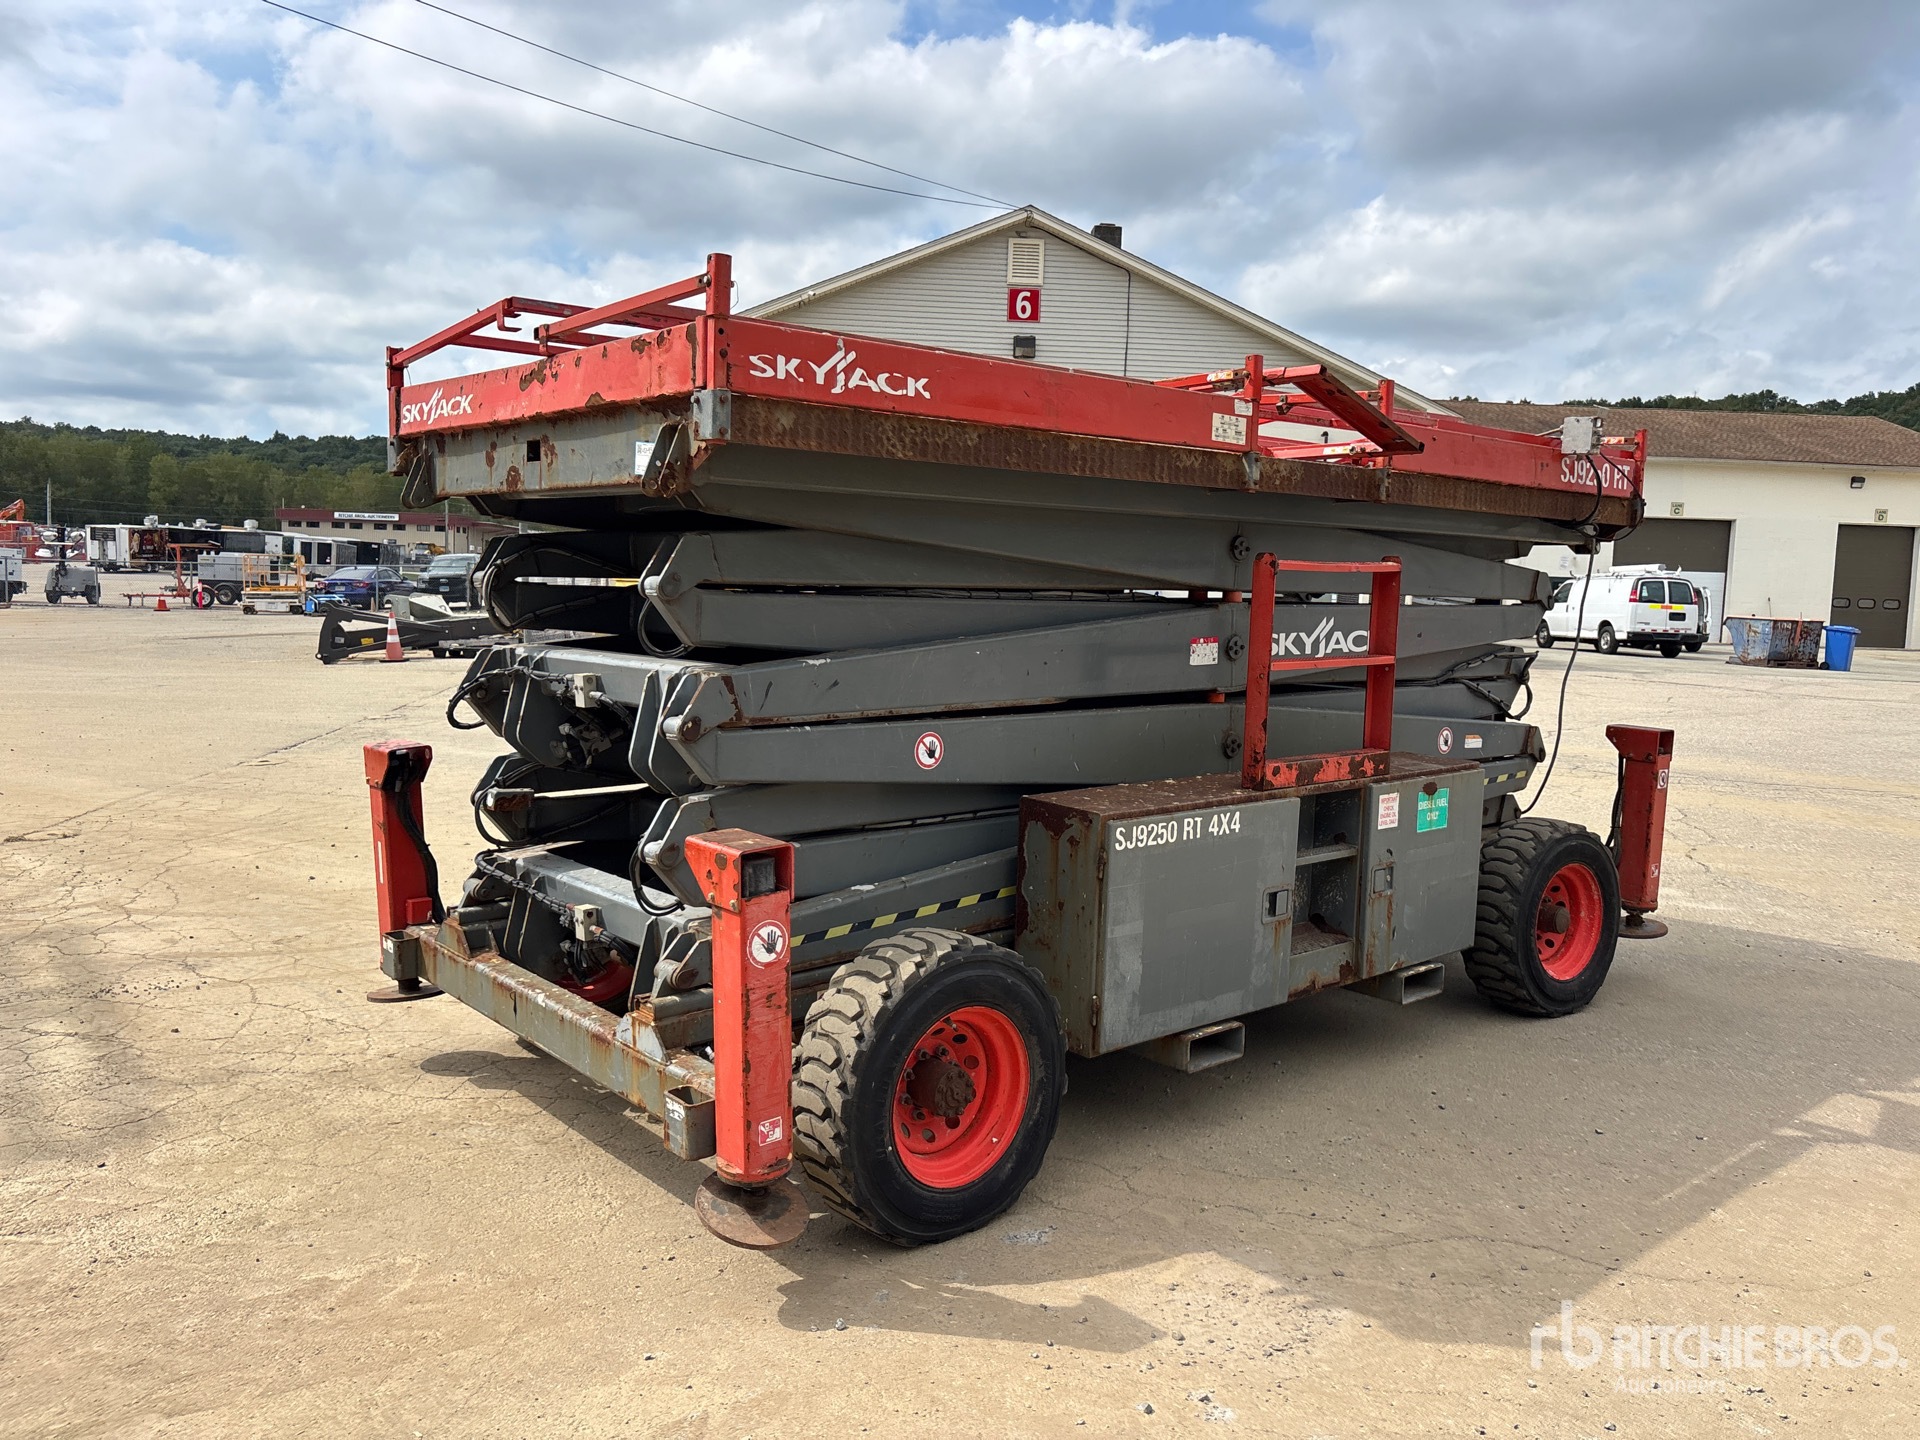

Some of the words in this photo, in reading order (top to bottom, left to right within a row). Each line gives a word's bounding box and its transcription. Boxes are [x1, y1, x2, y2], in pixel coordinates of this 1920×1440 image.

[1015, 291, 1032, 319] 6
[748, 338, 931, 399] SKYJACK
[402, 387, 474, 425] SKYJACK
[1560, 457, 1610, 488] SJ920
[1613, 464, 1631, 490] RT
[1271, 616, 1370, 658] SKYJAC
[1436, 798, 1448, 806] FUEL
[1115, 820, 1178, 851] SJ9250
[1182, 817, 1203, 841] RT
[1208, 811, 1241, 837] 4X4
